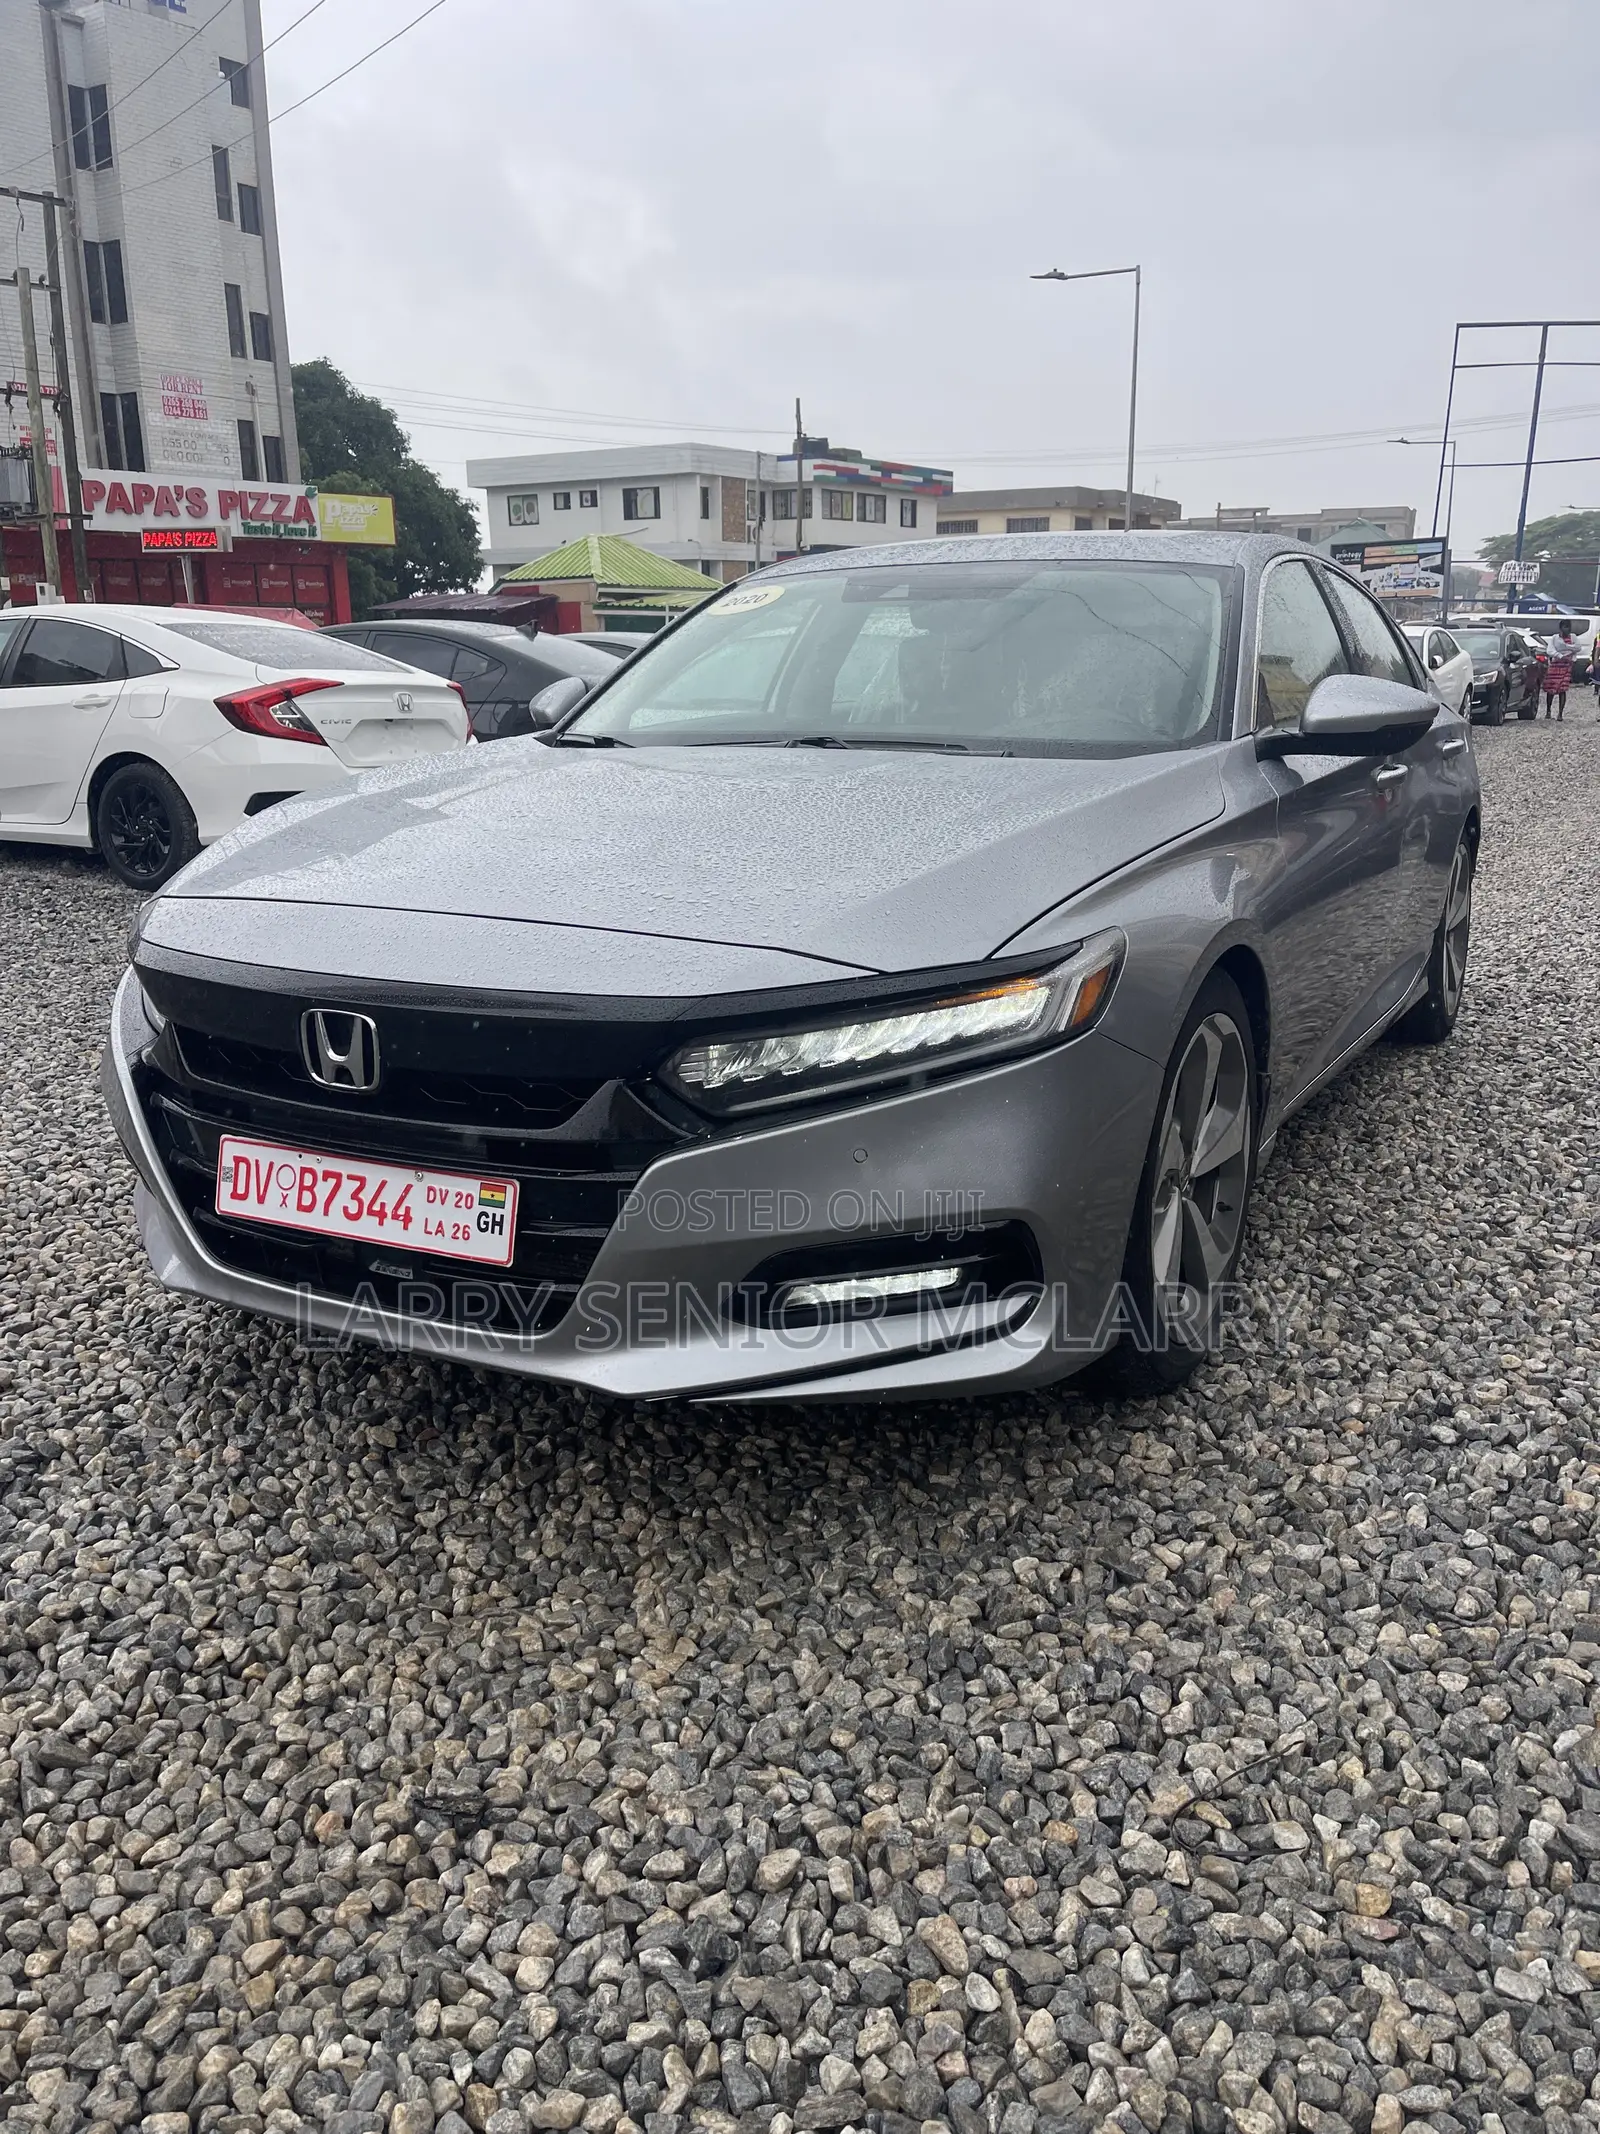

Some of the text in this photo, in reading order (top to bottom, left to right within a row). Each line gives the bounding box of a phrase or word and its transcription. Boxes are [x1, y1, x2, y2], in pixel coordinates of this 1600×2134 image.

[162, 381, 203, 395] FOR RENT
[82, 480, 317, 524] PAPA'S PIZZA
[143, 532, 217, 547] PAPA'S PIZZA
[241, 522, 272, 535] Taste
[284, 524, 308, 537] love
[308, 524, 318, 538] it
[720, 594, 768, 607] 2020
[230, 1155, 275, 1205] DV
[296, 1166, 414, 1231] B7344
[426, 1185, 474, 1210] DV 20
[424, 1217, 471, 1241] LA 26
[476, 1210, 505, 1236] GH
